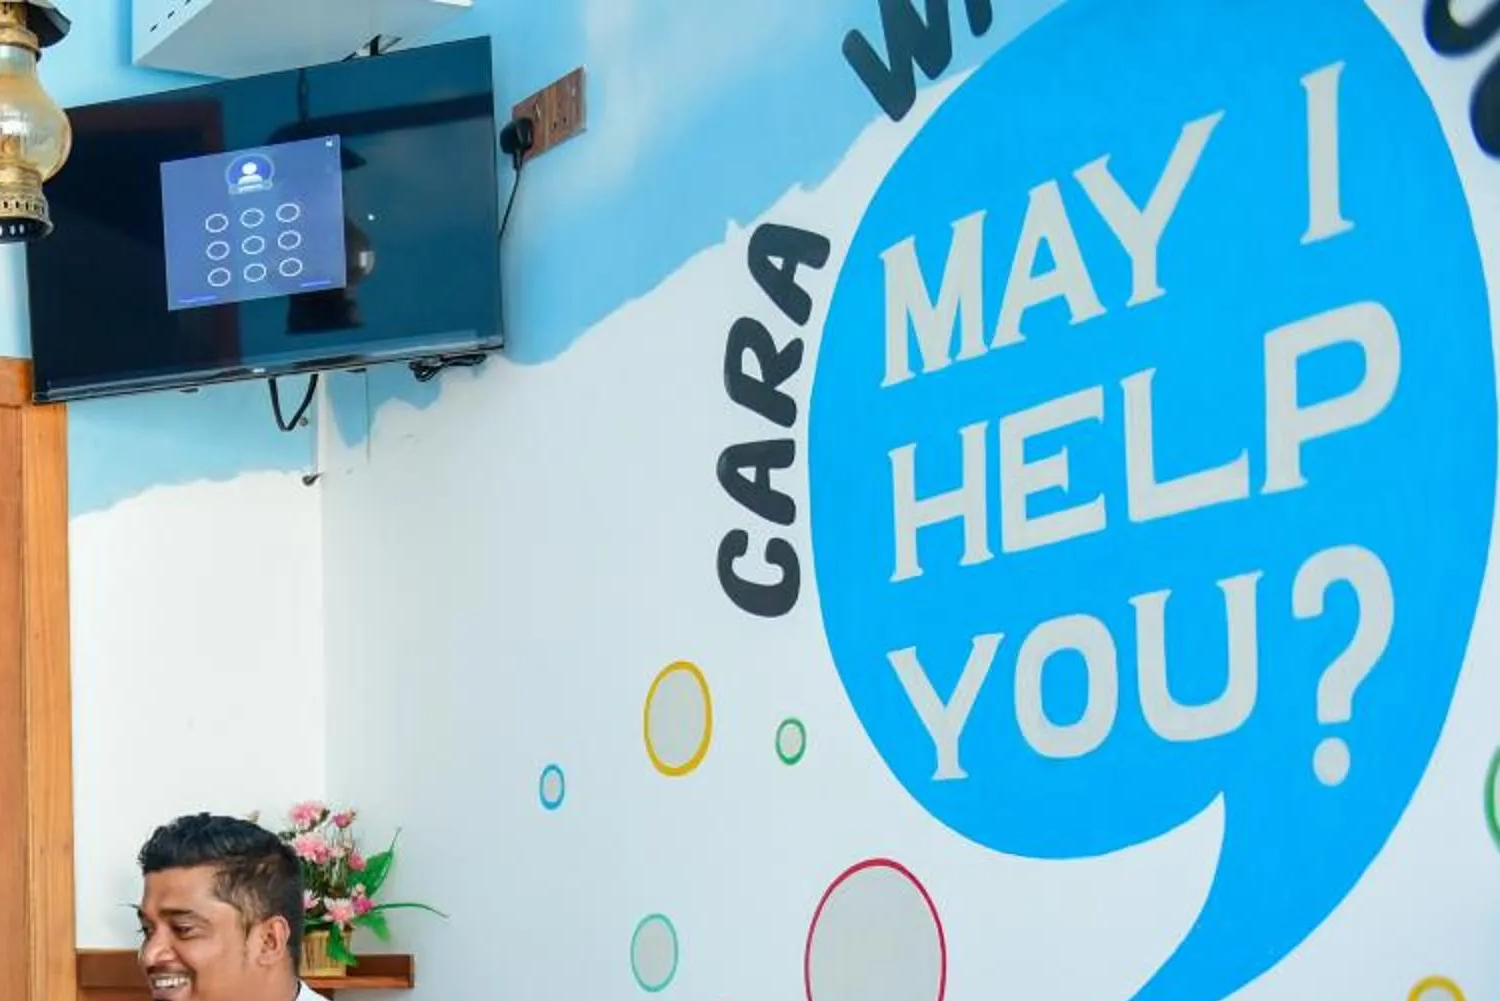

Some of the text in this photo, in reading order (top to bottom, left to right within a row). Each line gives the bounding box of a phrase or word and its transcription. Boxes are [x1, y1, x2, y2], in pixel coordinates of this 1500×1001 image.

[716, 0, 993, 618] CARA W
[878, 109, 1226, 388] MAY
[1299, 60, 1355, 246] I
[887, 300, 1402, 582] HELP
[886, 543, 1395, 787] YOU?
